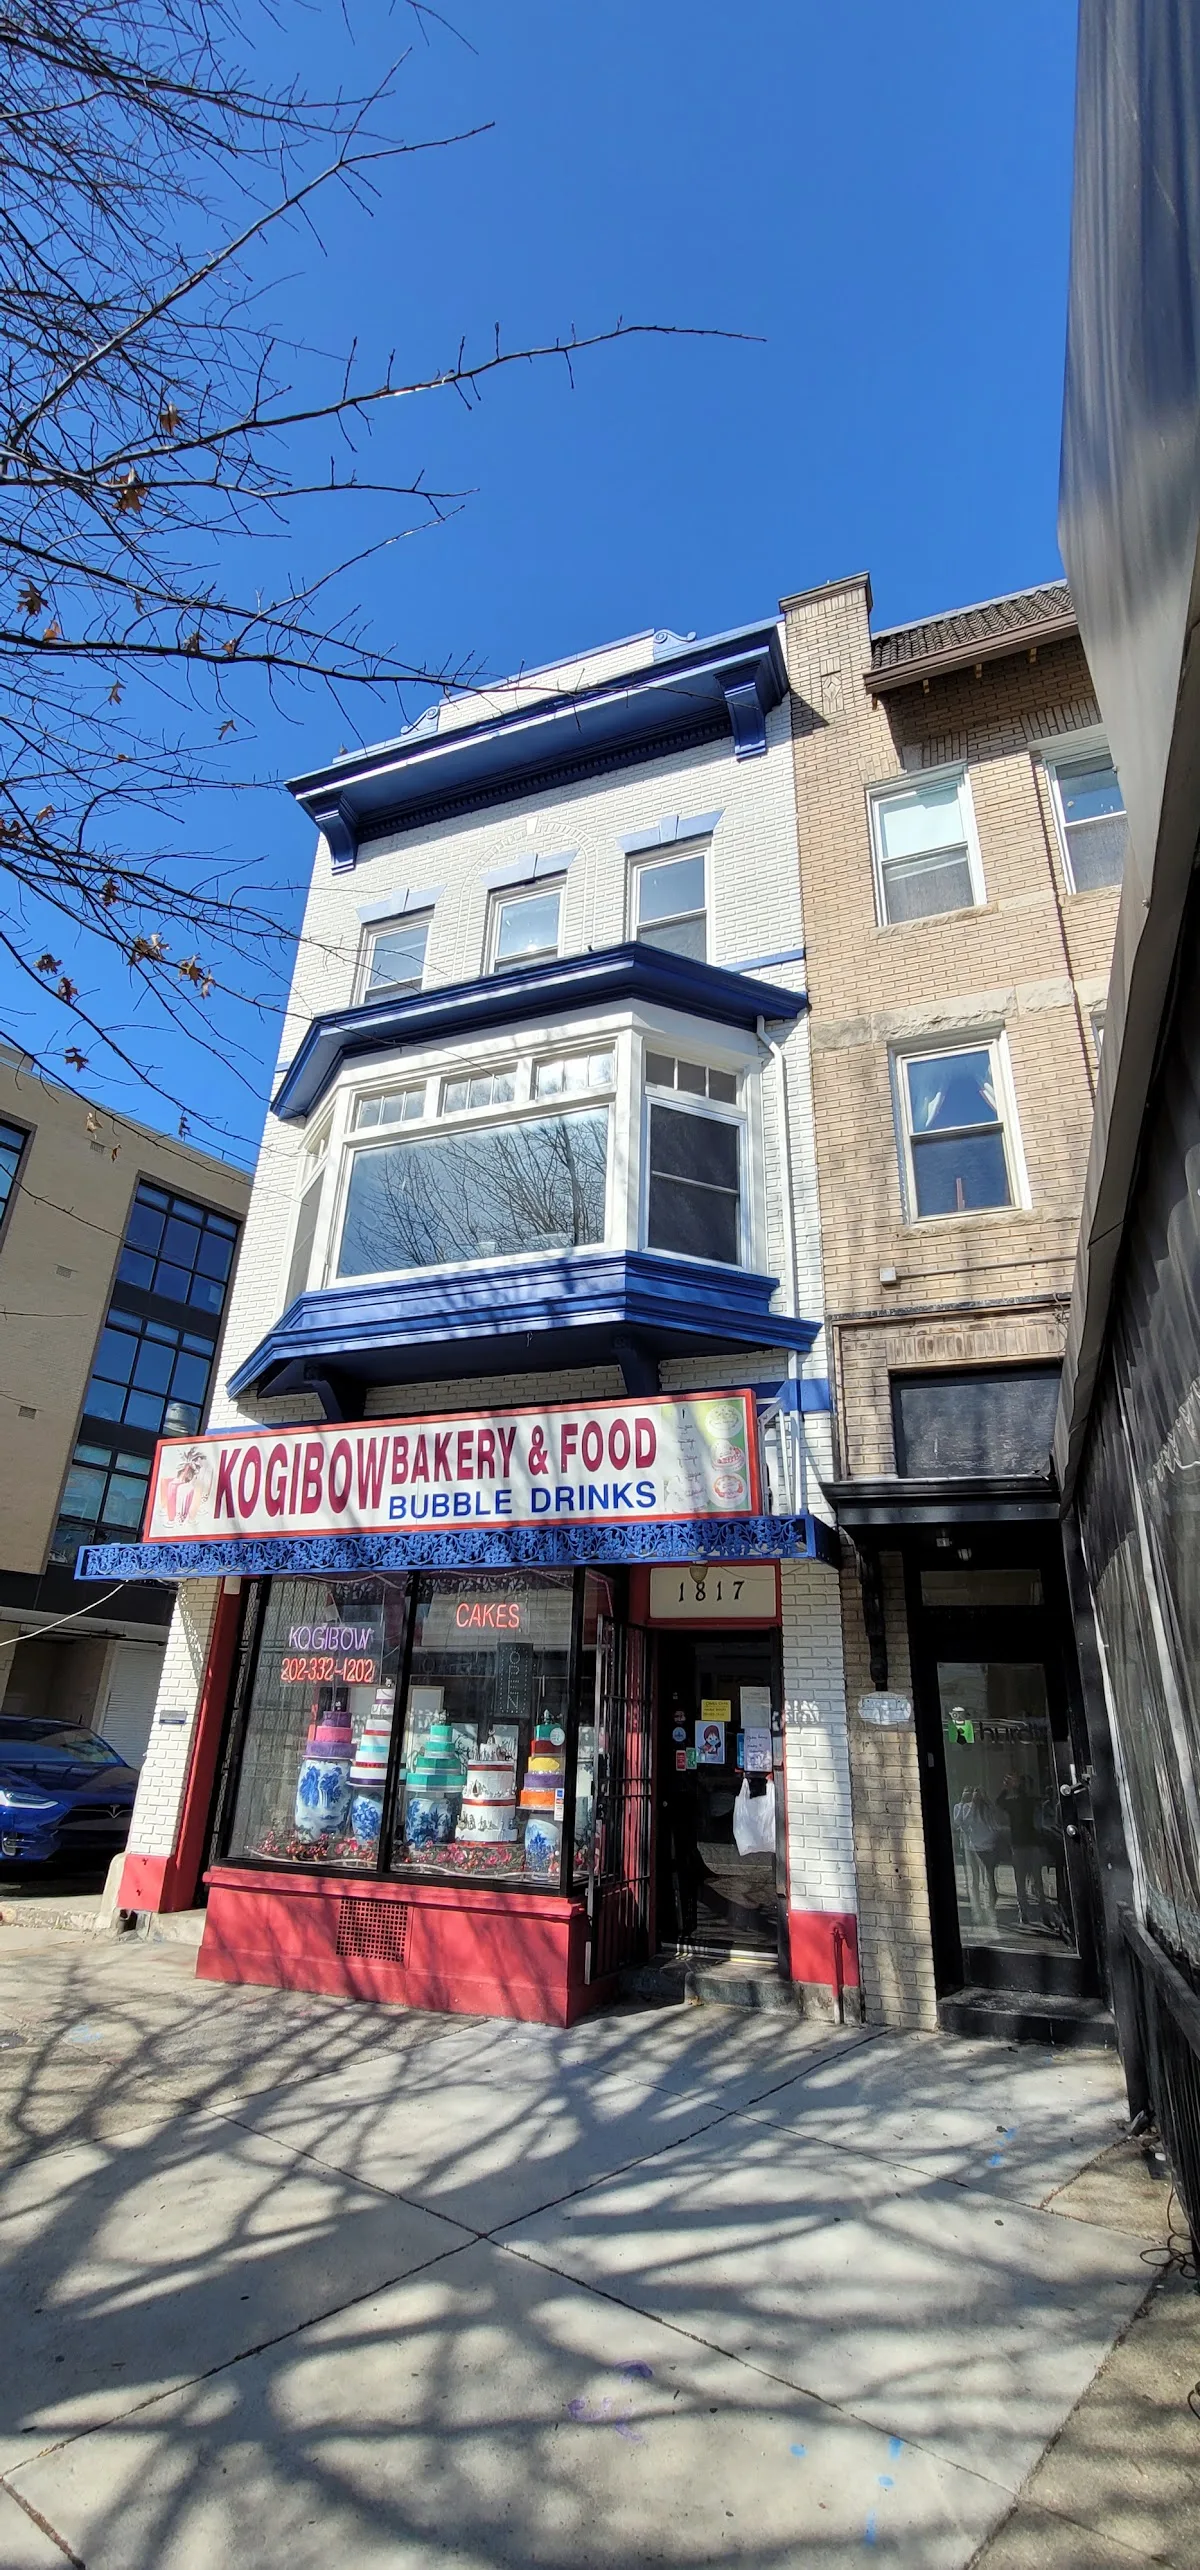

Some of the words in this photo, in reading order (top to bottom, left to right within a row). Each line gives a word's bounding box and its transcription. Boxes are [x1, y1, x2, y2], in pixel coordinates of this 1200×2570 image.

[214, 1435, 391, 1519] KOGIBOW
[391, 1426, 517, 1484] BAKERY
[528, 1425, 549, 1476] &
[560, 1417, 657, 1474] FOOD
[389, 1489, 513, 1520] BUBBLE
[531, 1480, 657, 1513] DRINKS
[678, 1580, 745, 1602] 1817
[456, 1602, 520, 1628] CAKES
[288, 1625, 373, 1650] KOGIBOW
[280, 1657, 375, 1683] 202-332-1202
[506, 1650, 521, 1711] OPEN
